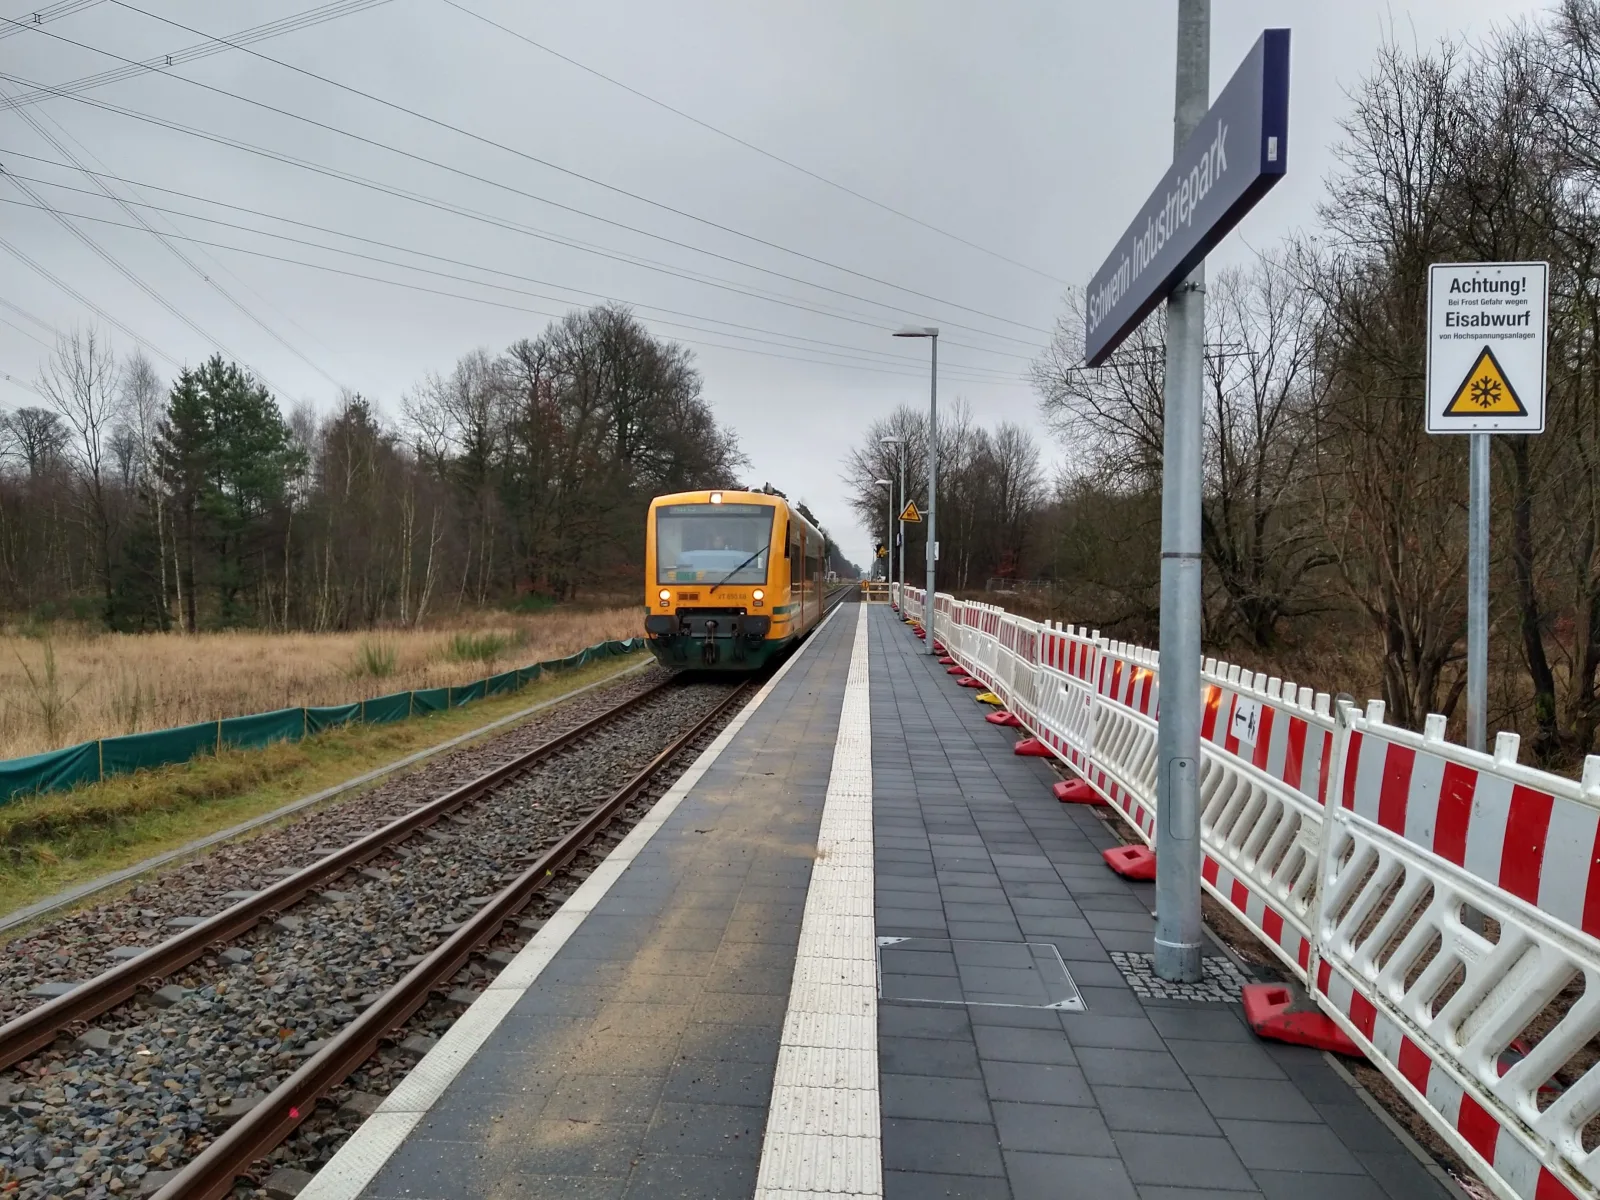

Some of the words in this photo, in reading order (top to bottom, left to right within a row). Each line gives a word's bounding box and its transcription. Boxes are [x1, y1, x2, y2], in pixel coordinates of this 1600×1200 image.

[1089, 254, 1130, 334] Schwerin
[1132, 118, 1228, 282] Industriepark
[1449, 277, 1526, 296] Achtung!
[1480, 298, 1503, 306] Gefahr
[1505, 299, 1528, 307] wegen
[1445, 310, 1531, 327] Eisabwurf
[1453, 332, 1536, 341] Hochspannungsanlagen
